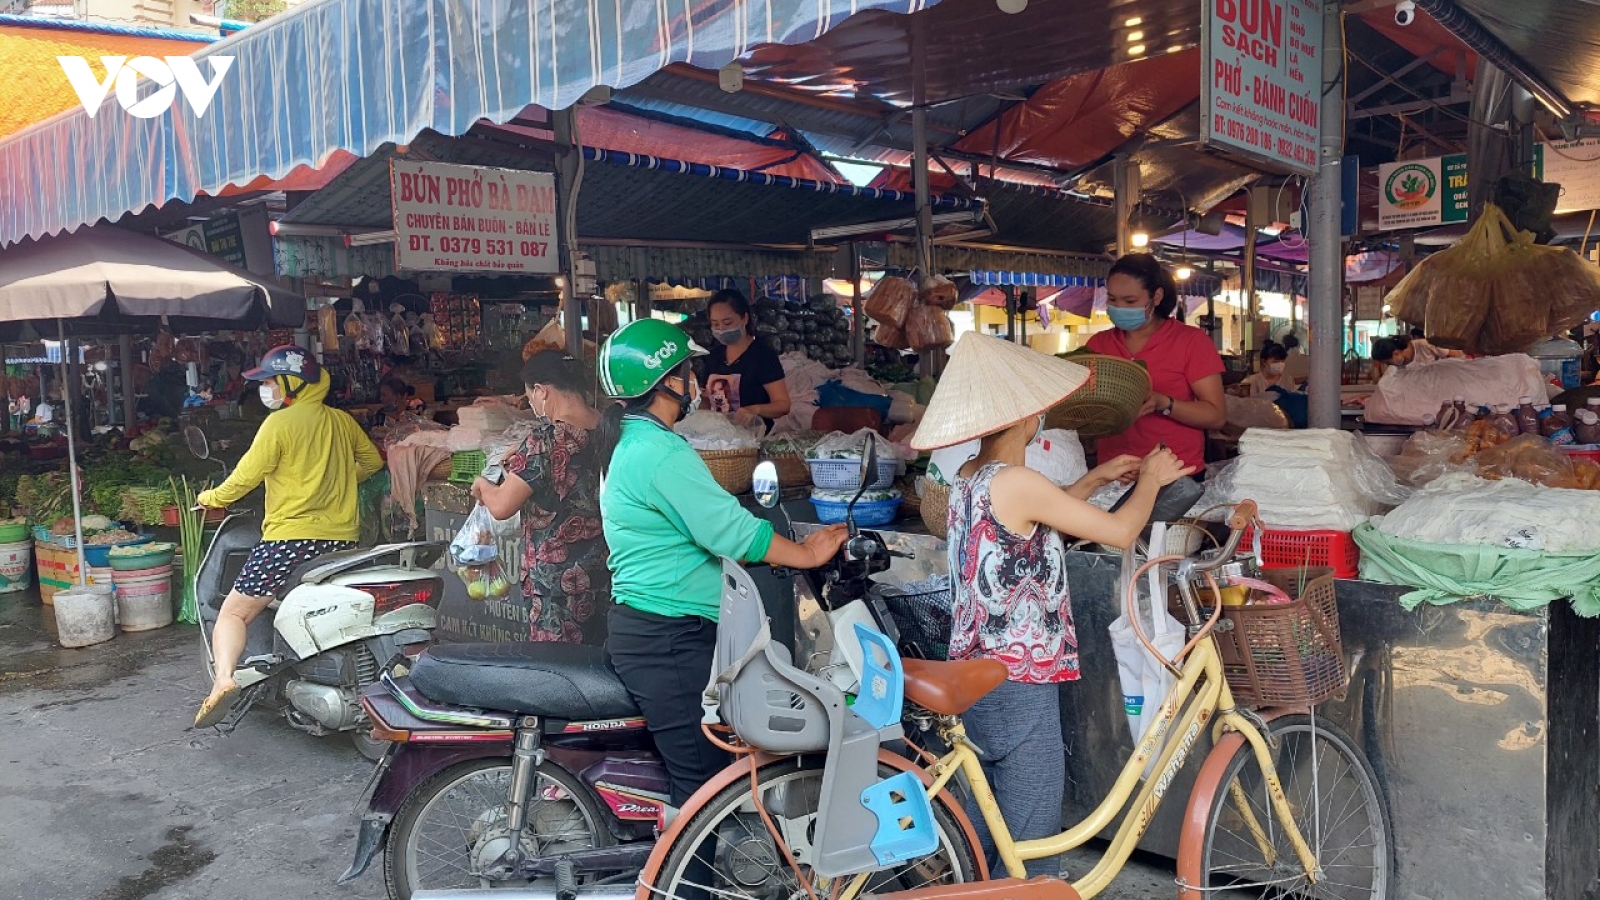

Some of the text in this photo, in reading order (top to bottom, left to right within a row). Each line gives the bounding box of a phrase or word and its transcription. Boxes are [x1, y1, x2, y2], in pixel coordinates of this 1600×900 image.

[1222, 24, 1277, 68] SẠCH
[1215, 58, 1241, 97] PHỞ
[1254, 75, 1285, 116] BÁNH
[1289, 90, 1318, 129] CUỐN
[400, 166, 440, 204] BÚN
[446, 169, 483, 208] PHỞ
[487, 175, 512, 211] BÀ
[407, 212, 450, 231] CHUYÊN
[453, 214, 475, 232] BÁN
[478, 217, 506, 234] BUÔN
[516, 219, 536, 236] BÁN
[539, 219, 550, 237] LẺ
[409, 235, 548, 258] ĐT. 0379 531 087
[434, 258, 459, 268] Không
[643, 339, 678, 369] Grab
[440, 614, 460, 632] CAM
[583, 720, 626, 731] HONDA
